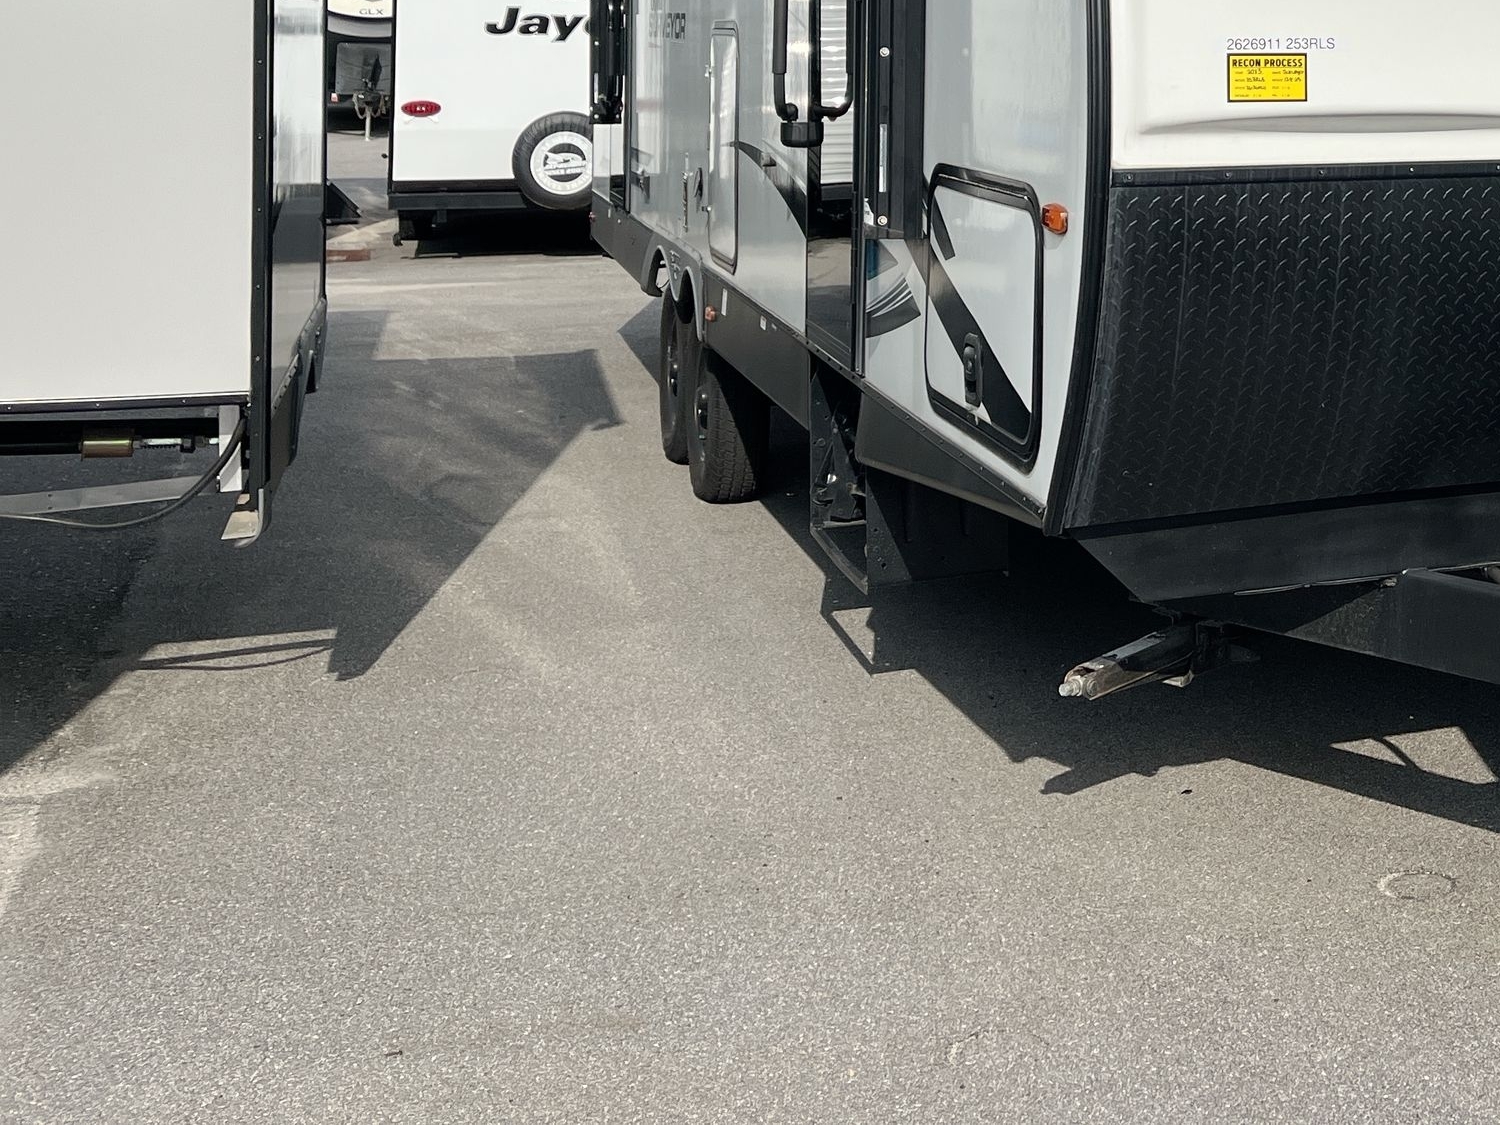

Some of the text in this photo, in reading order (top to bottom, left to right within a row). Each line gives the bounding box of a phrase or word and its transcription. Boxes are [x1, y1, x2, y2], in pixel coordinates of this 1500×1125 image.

[358, 8, 385, 16] GLX
[1226, 37, 1336, 51] 2626911 253RLS
[1231, 58, 1304, 68] RECON PROCESS
